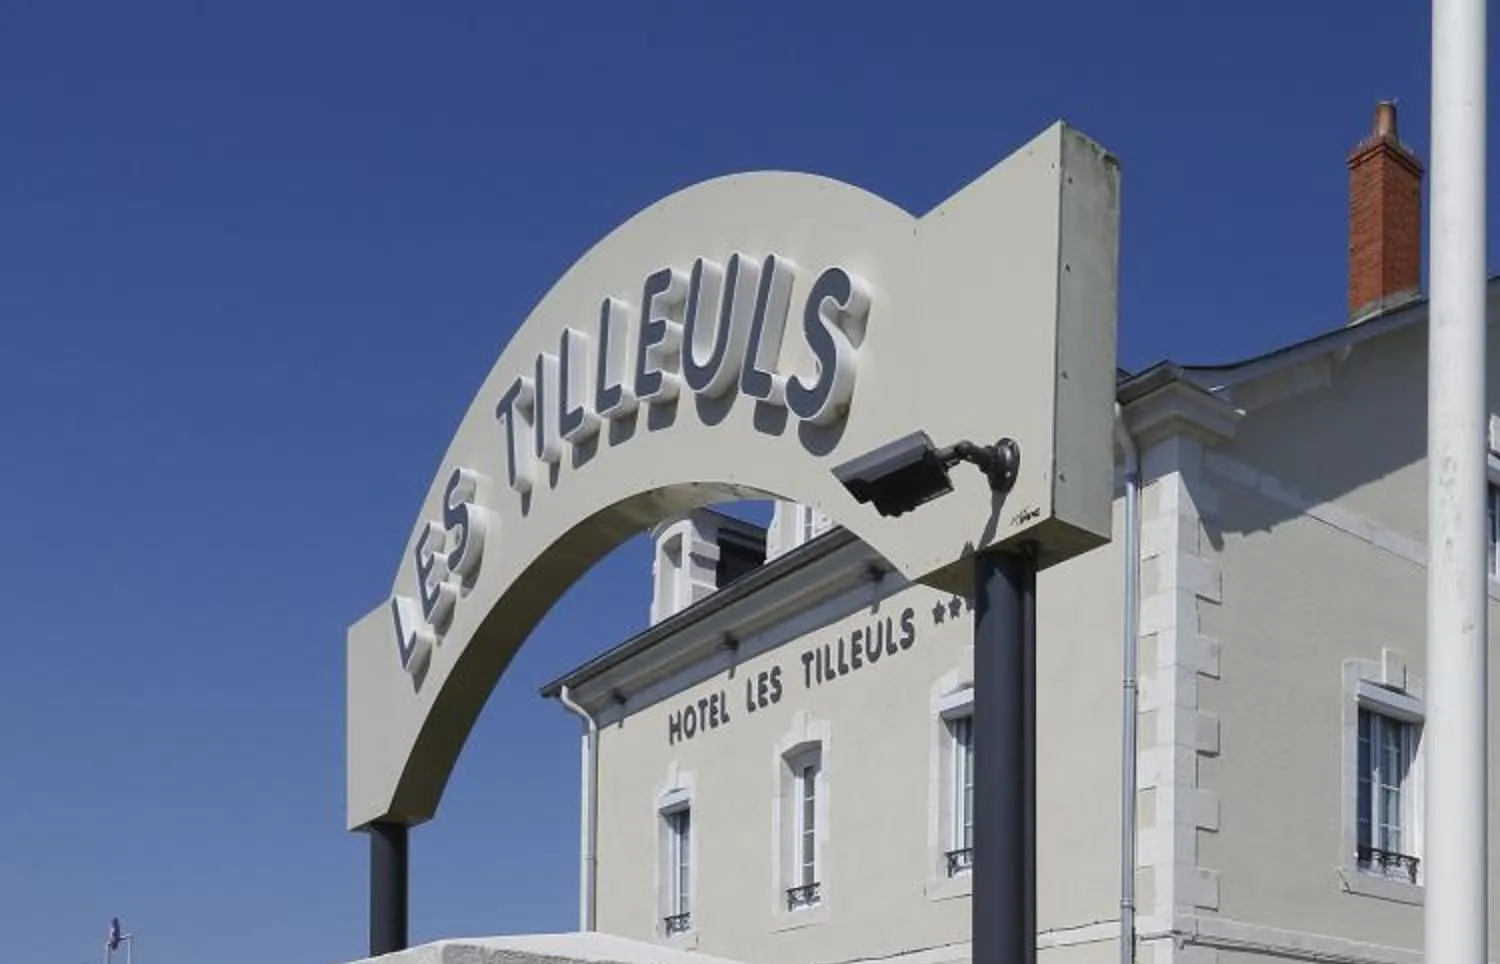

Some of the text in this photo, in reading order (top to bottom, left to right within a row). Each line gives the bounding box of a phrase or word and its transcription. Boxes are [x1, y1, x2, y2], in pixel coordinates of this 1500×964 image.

[391, 251, 862, 675] LES TILLEULS
[668, 607, 915, 746] HOTEL LES TILLEULS
